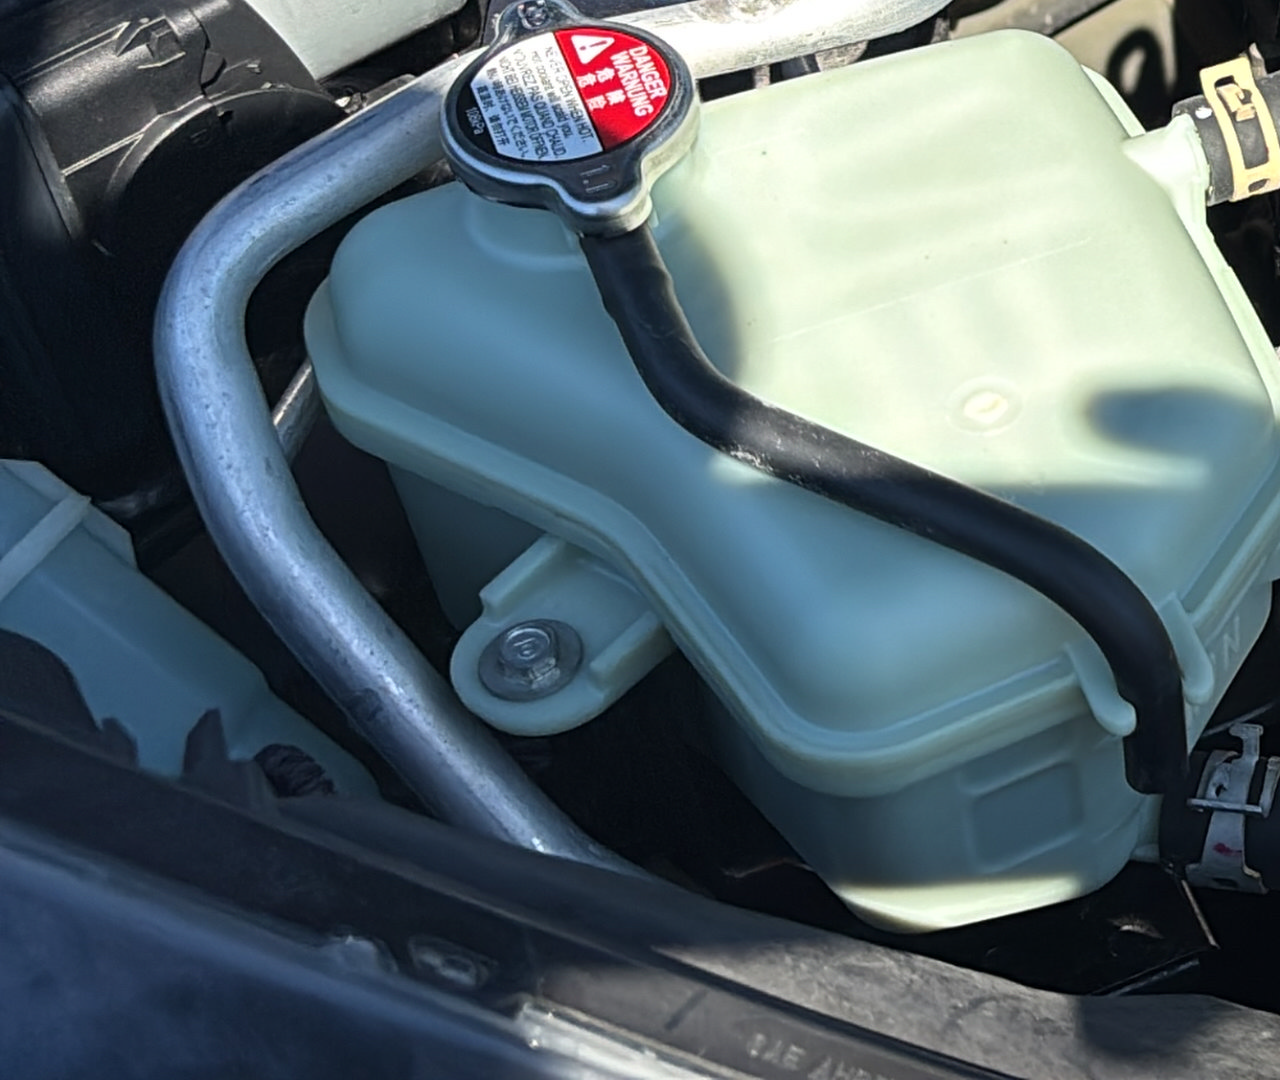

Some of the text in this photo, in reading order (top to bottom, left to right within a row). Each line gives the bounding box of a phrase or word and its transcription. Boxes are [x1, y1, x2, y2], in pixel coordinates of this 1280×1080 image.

[503, 73, 517, 85] BEI
[608, 51, 655, 117] WARNUNG
[628, 44, 668, 98] DANGER
[525, 85, 543, 103] PAS
[542, 46, 593, 141] NEVER OPEN WHEN HOT.
[546, 91, 559, 102] will
[532, 101, 555, 129] QUAND
